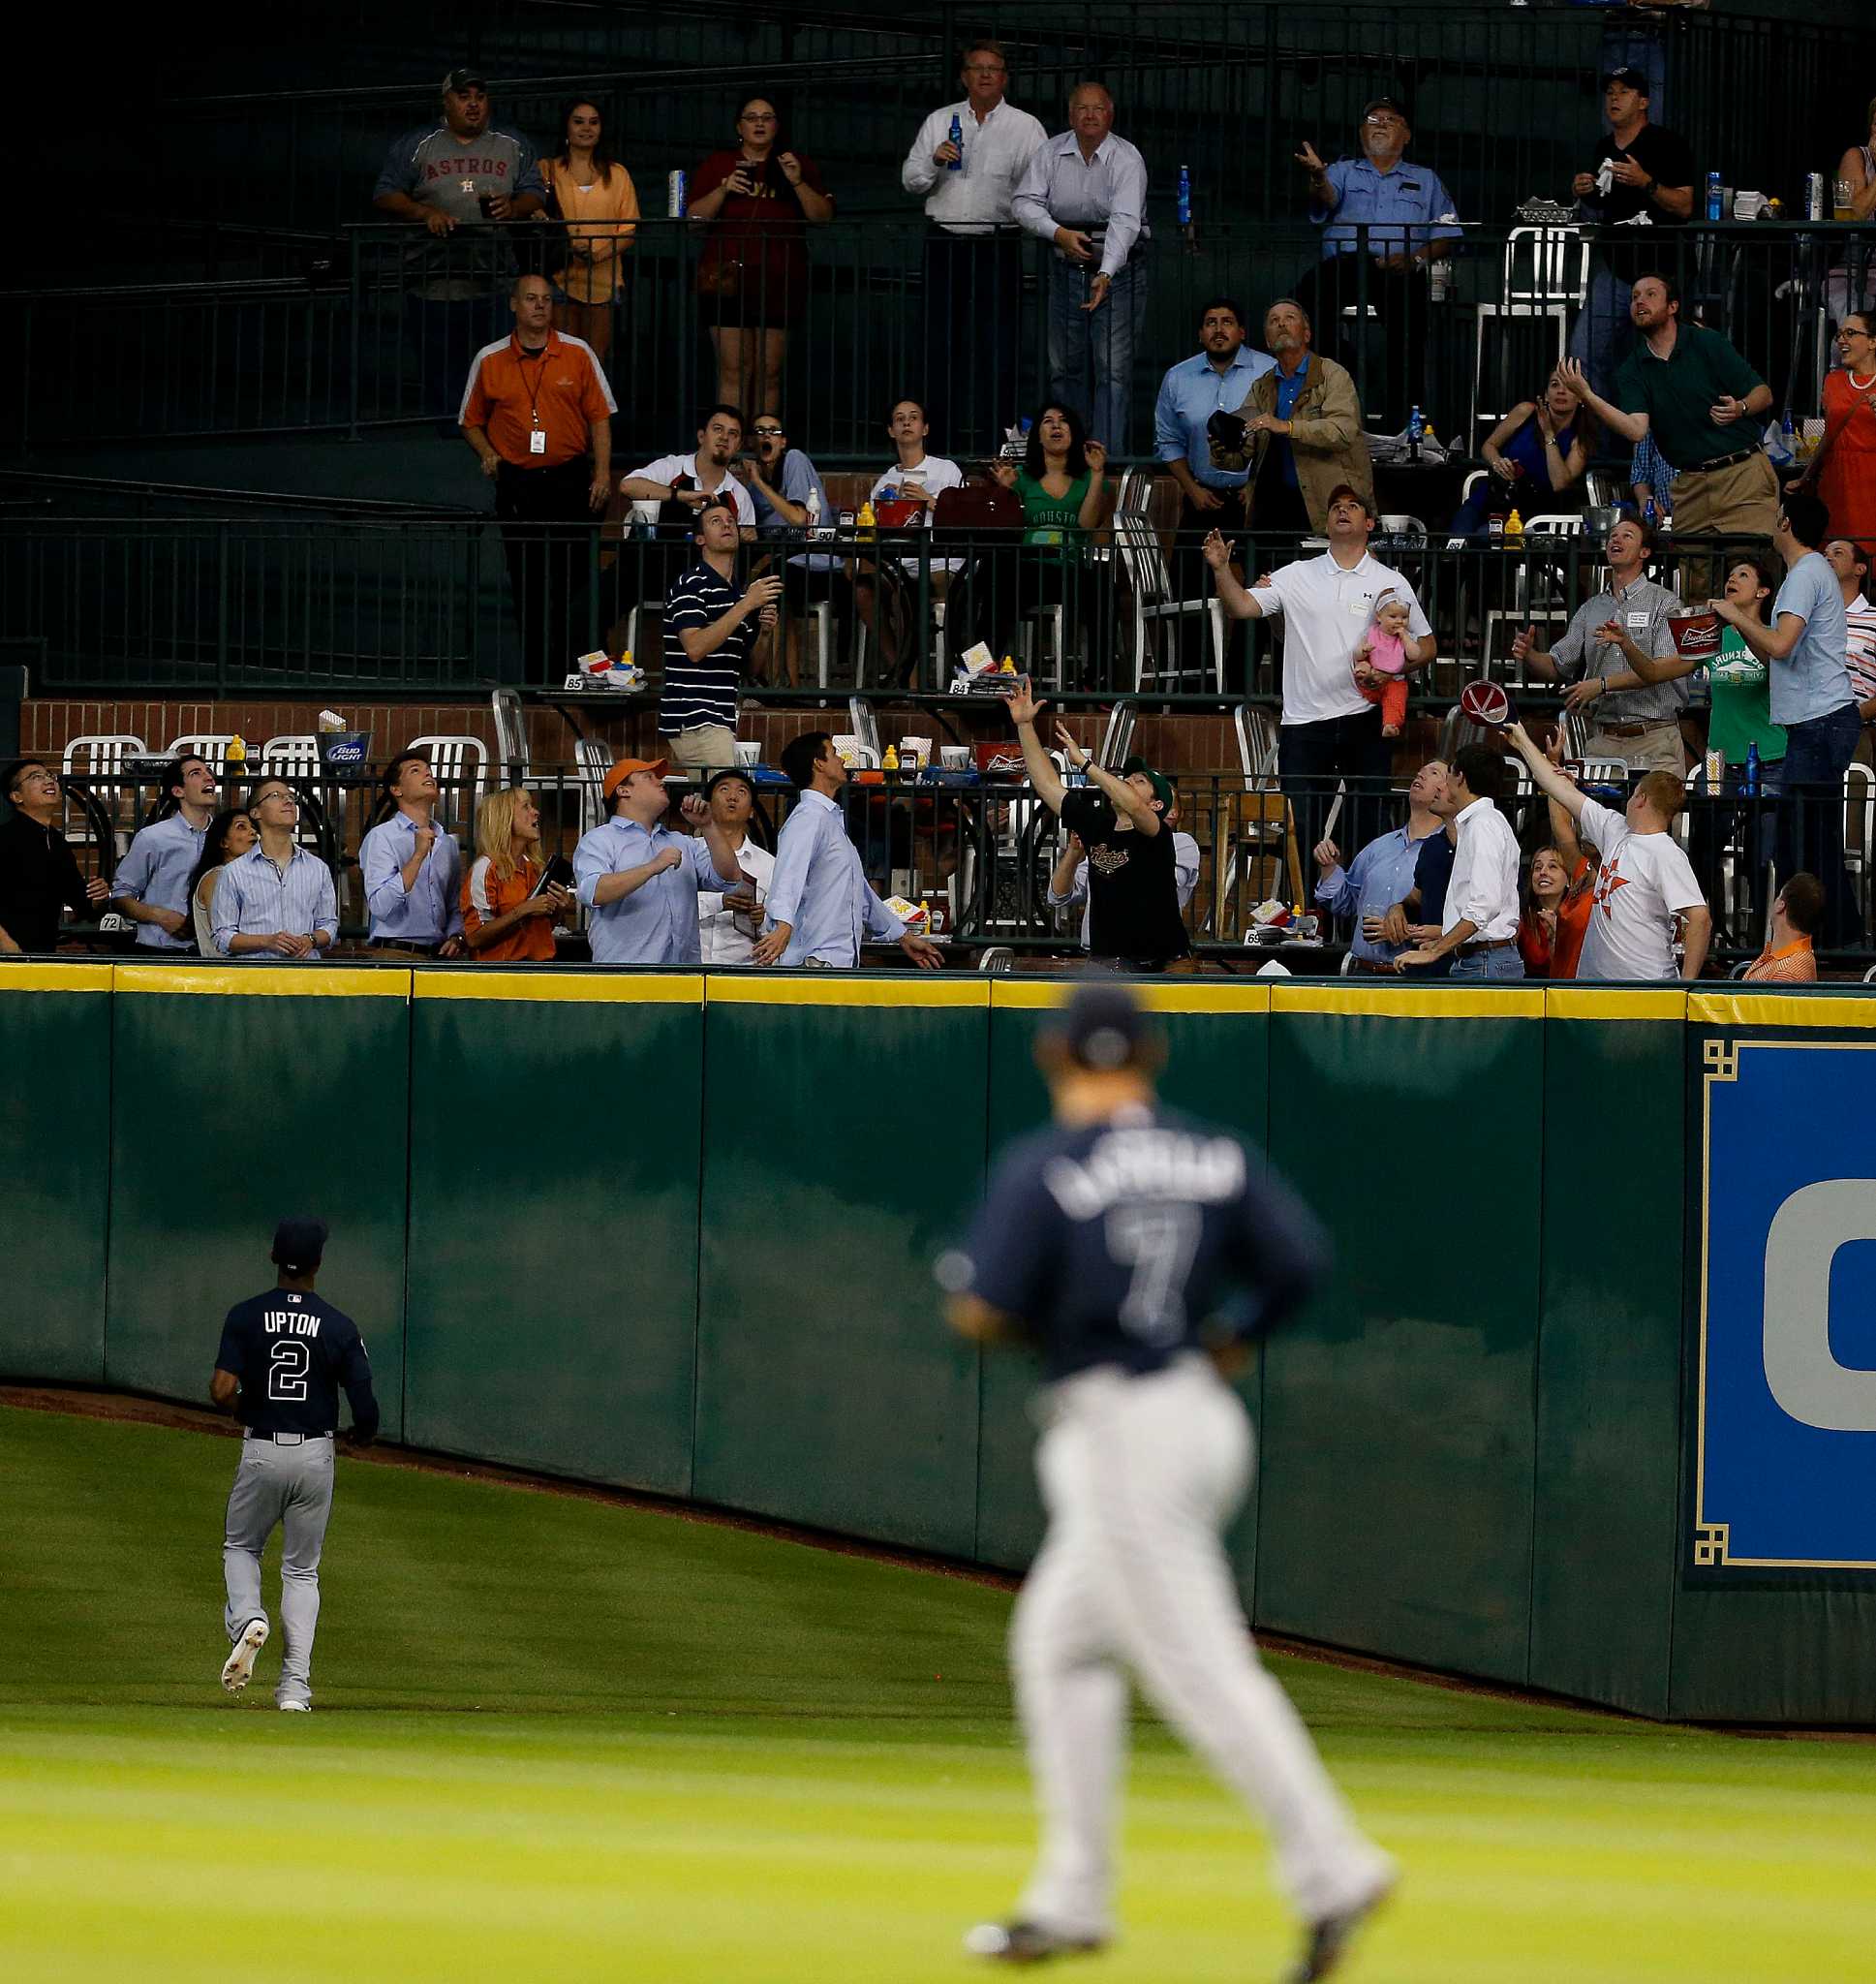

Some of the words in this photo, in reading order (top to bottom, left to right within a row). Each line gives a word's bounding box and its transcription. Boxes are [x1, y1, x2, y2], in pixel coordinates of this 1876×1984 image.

[425, 157, 507, 180] ASTROS
[1031, 511, 1078, 524] HOUSTO
[819, 531, 833, 541] 90
[568, 679, 581, 688] 85
[954, 684, 966, 693] 84
[104, 917, 116, 928] 72
[1247, 933, 1261, 943] 69
[264, 1311, 321, 1338] UPTON
[268, 1340, 309, 1401] 2
